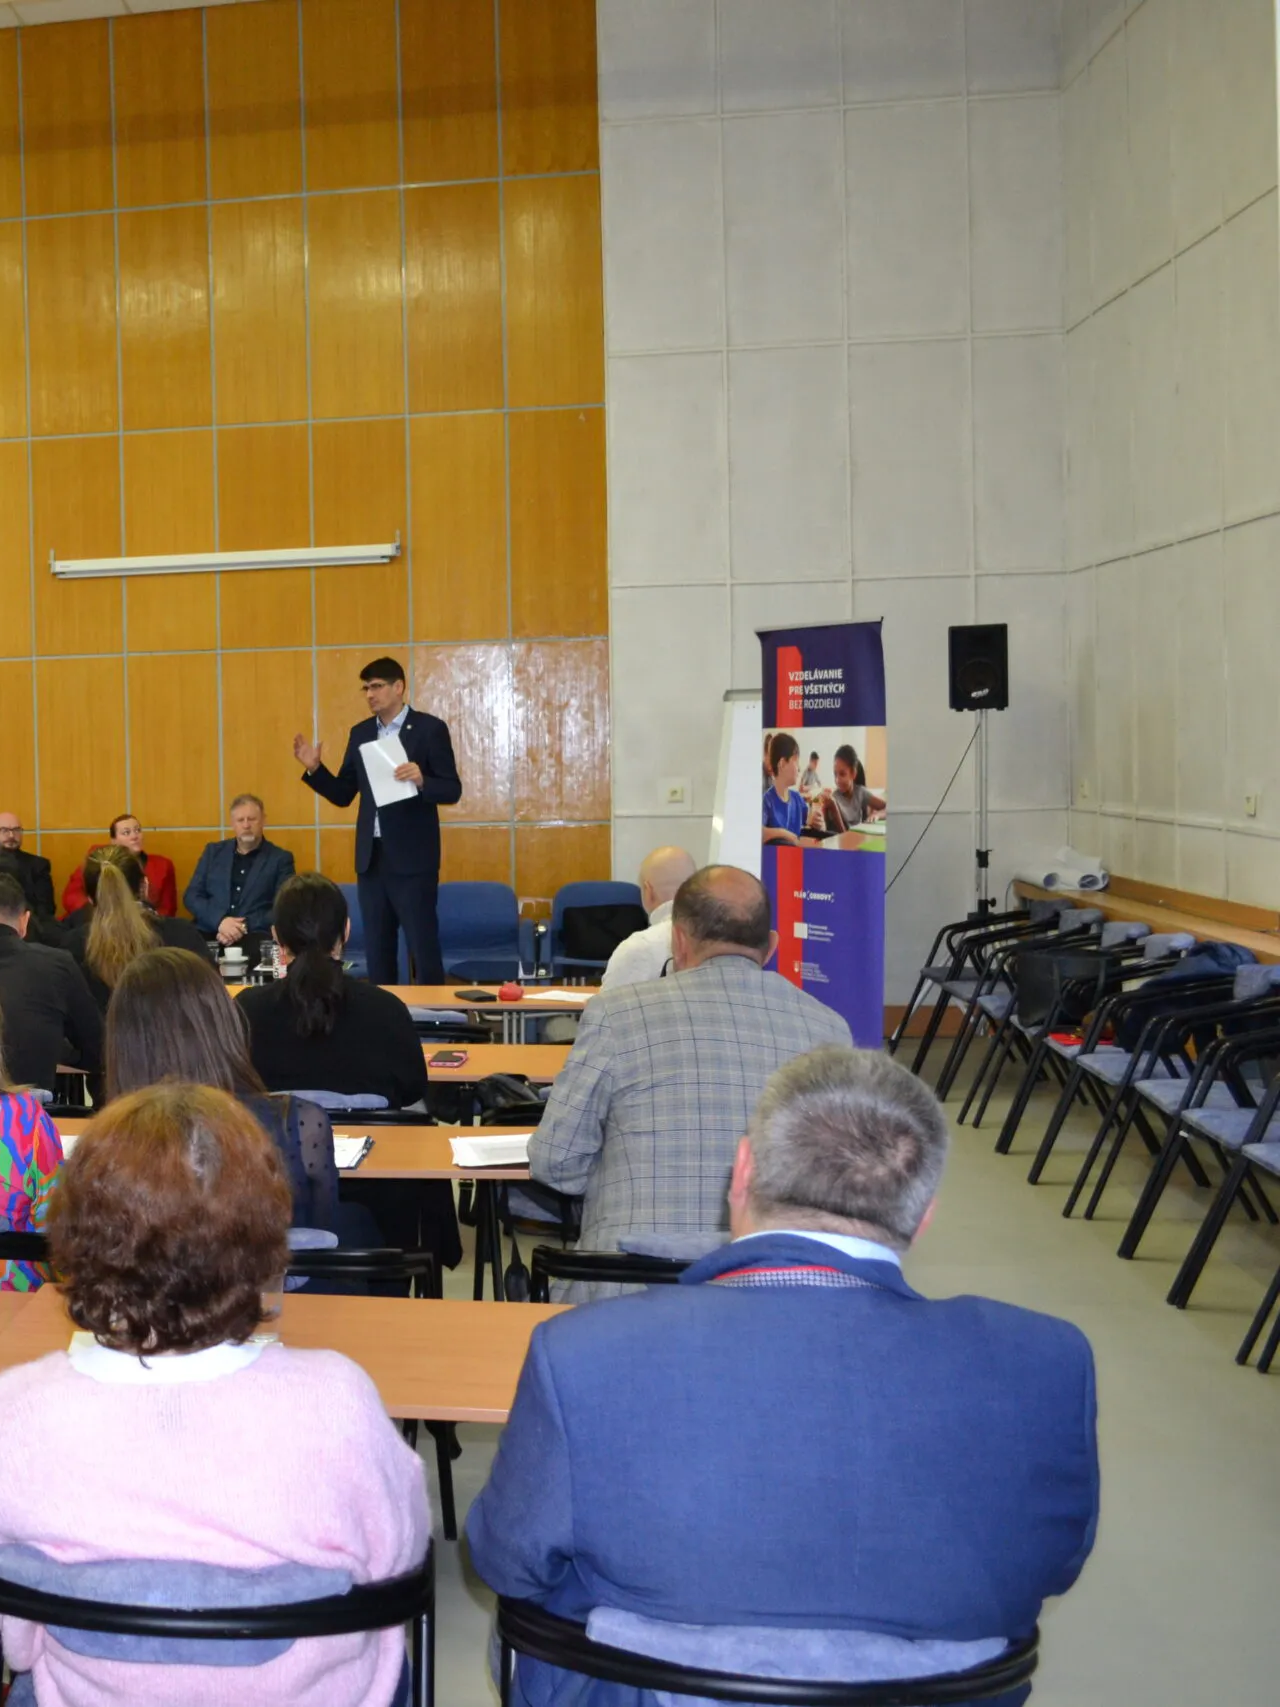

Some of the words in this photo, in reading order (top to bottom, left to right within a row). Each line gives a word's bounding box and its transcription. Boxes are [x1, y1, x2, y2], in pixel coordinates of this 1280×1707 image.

[788, 668, 843, 681] VZDELÁVANIE
[789, 685, 803, 695] PRE
[804, 682, 845, 695] VŠETKÝCH
[789, 699, 803, 710] BEZ
[804, 698, 841, 709] ROZDIELU
